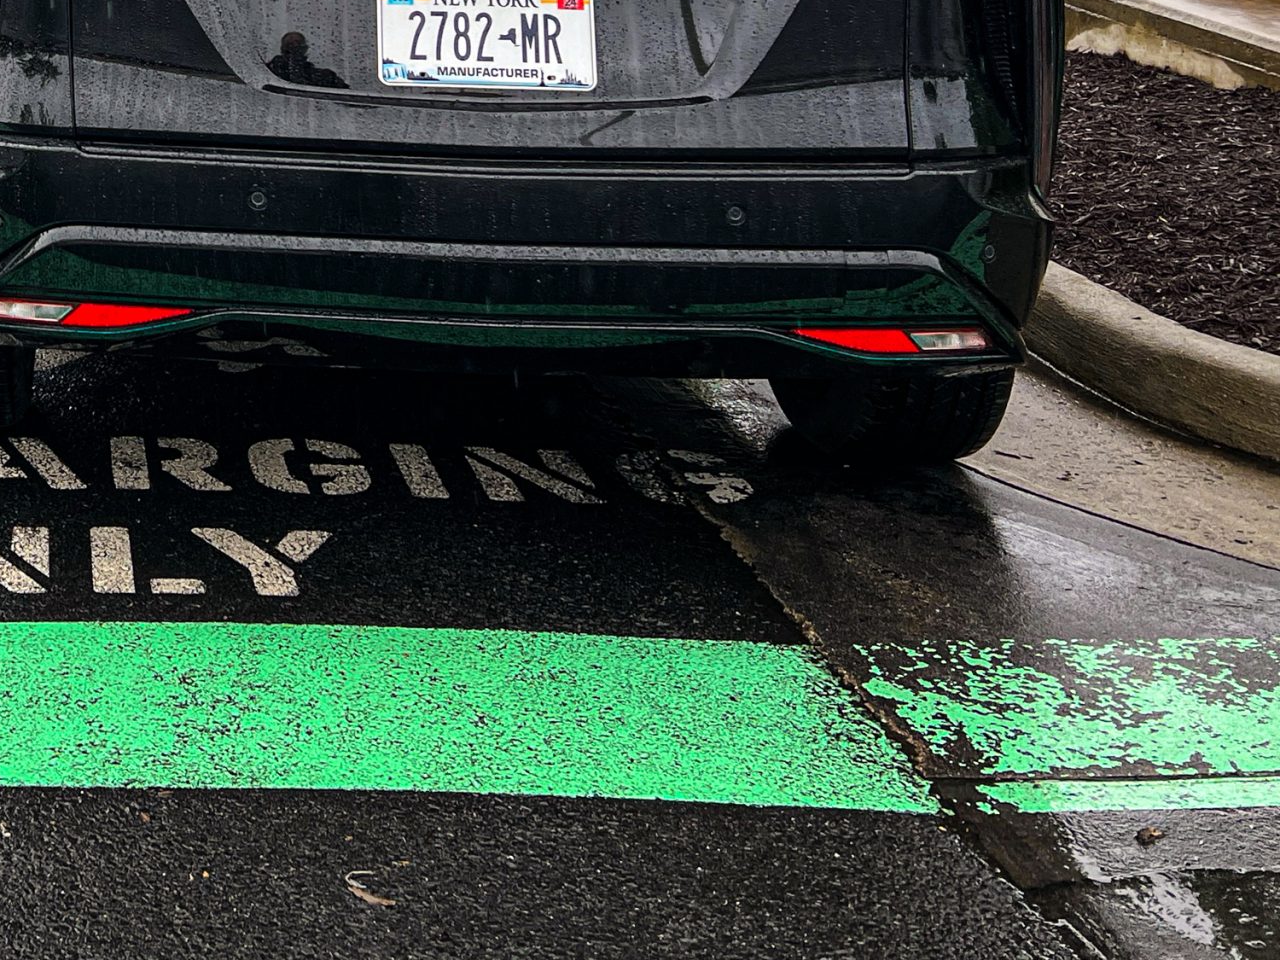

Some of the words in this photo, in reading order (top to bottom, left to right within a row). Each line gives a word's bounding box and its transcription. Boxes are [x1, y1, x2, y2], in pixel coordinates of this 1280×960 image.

[408, 10, 494, 62] 2782
[520, 13, 563, 64] MR
[437, 66, 539, 79] MANUFACTURER
